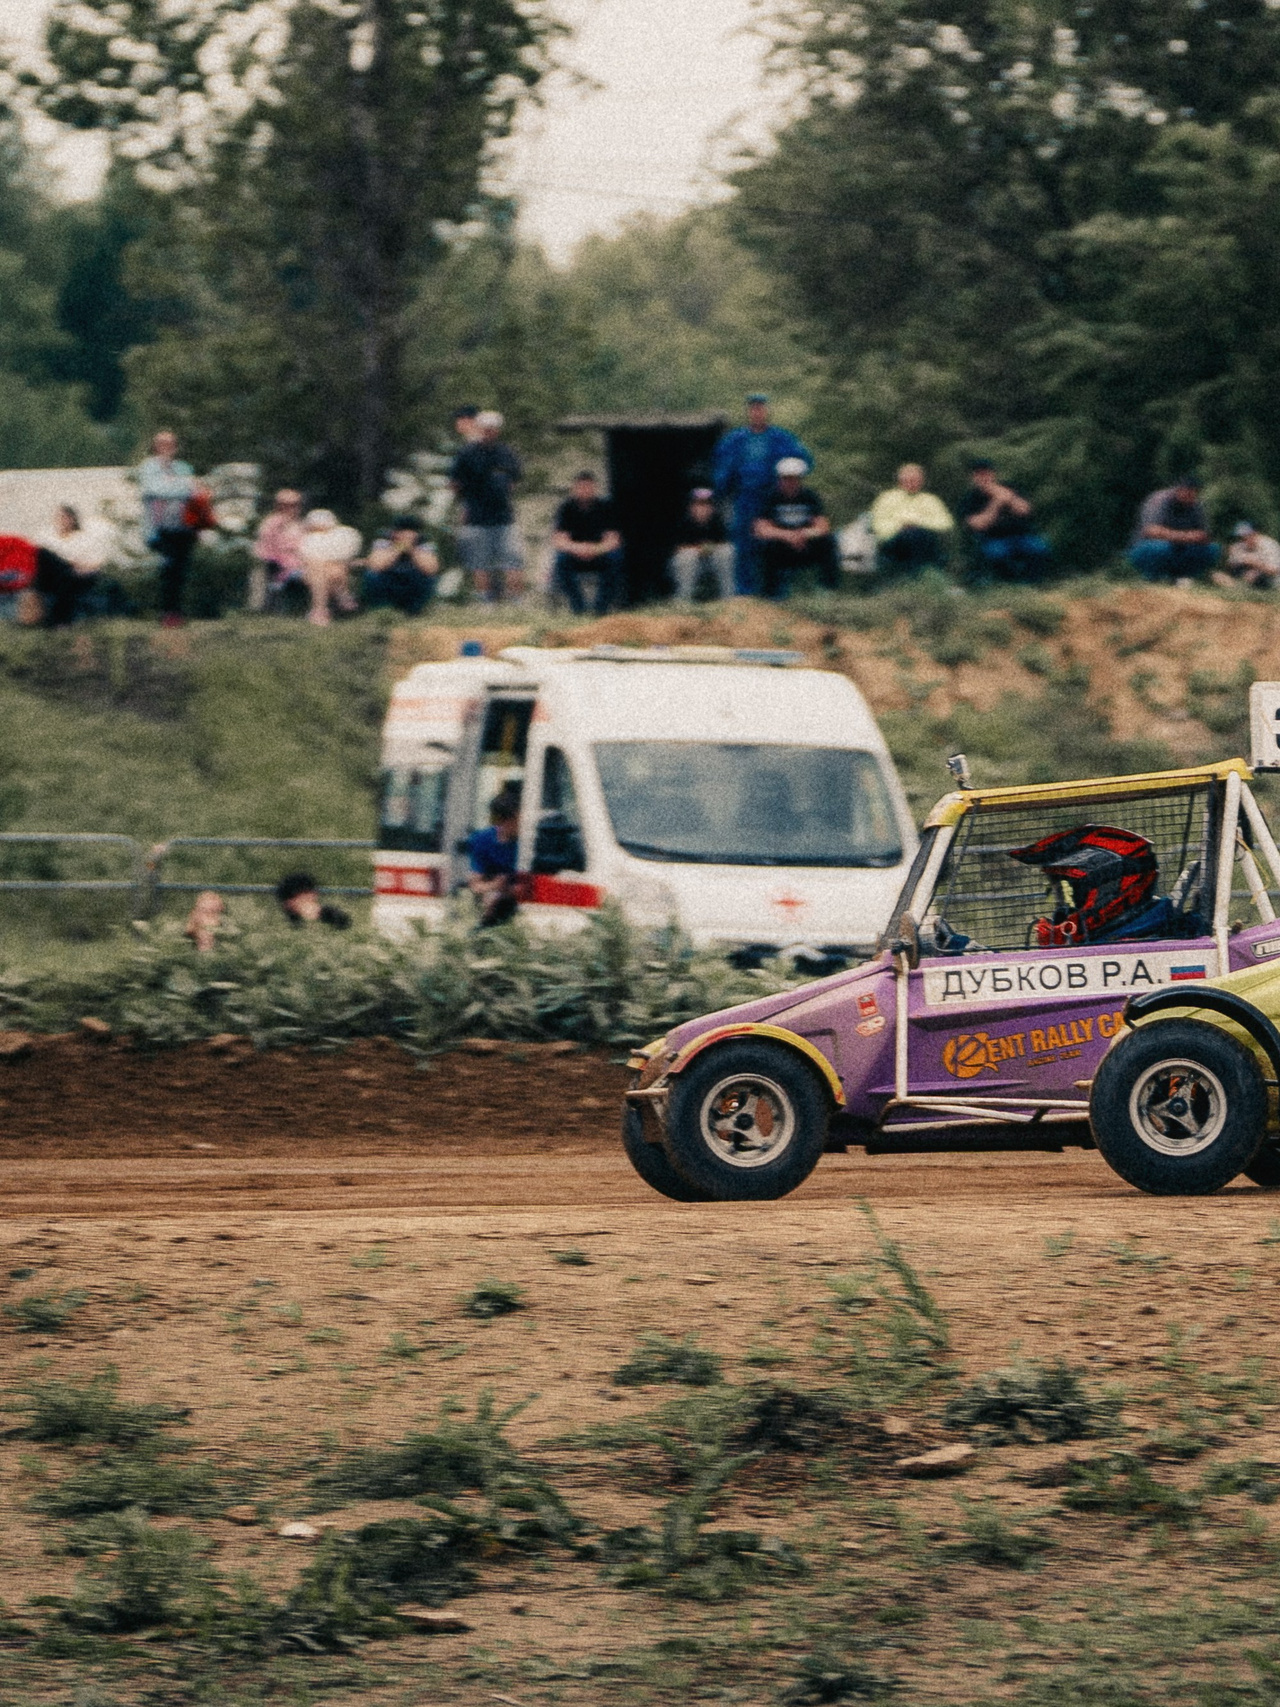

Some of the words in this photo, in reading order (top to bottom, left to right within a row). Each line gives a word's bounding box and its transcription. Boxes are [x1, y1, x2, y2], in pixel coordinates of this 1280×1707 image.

[941, 962, 1089, 1000] ДУБКОВ
[1102, 958, 1163, 987] Р.А.
[1029, 1017, 1094, 1054] RALLY
[1097, 1011, 1125, 1038] CA
